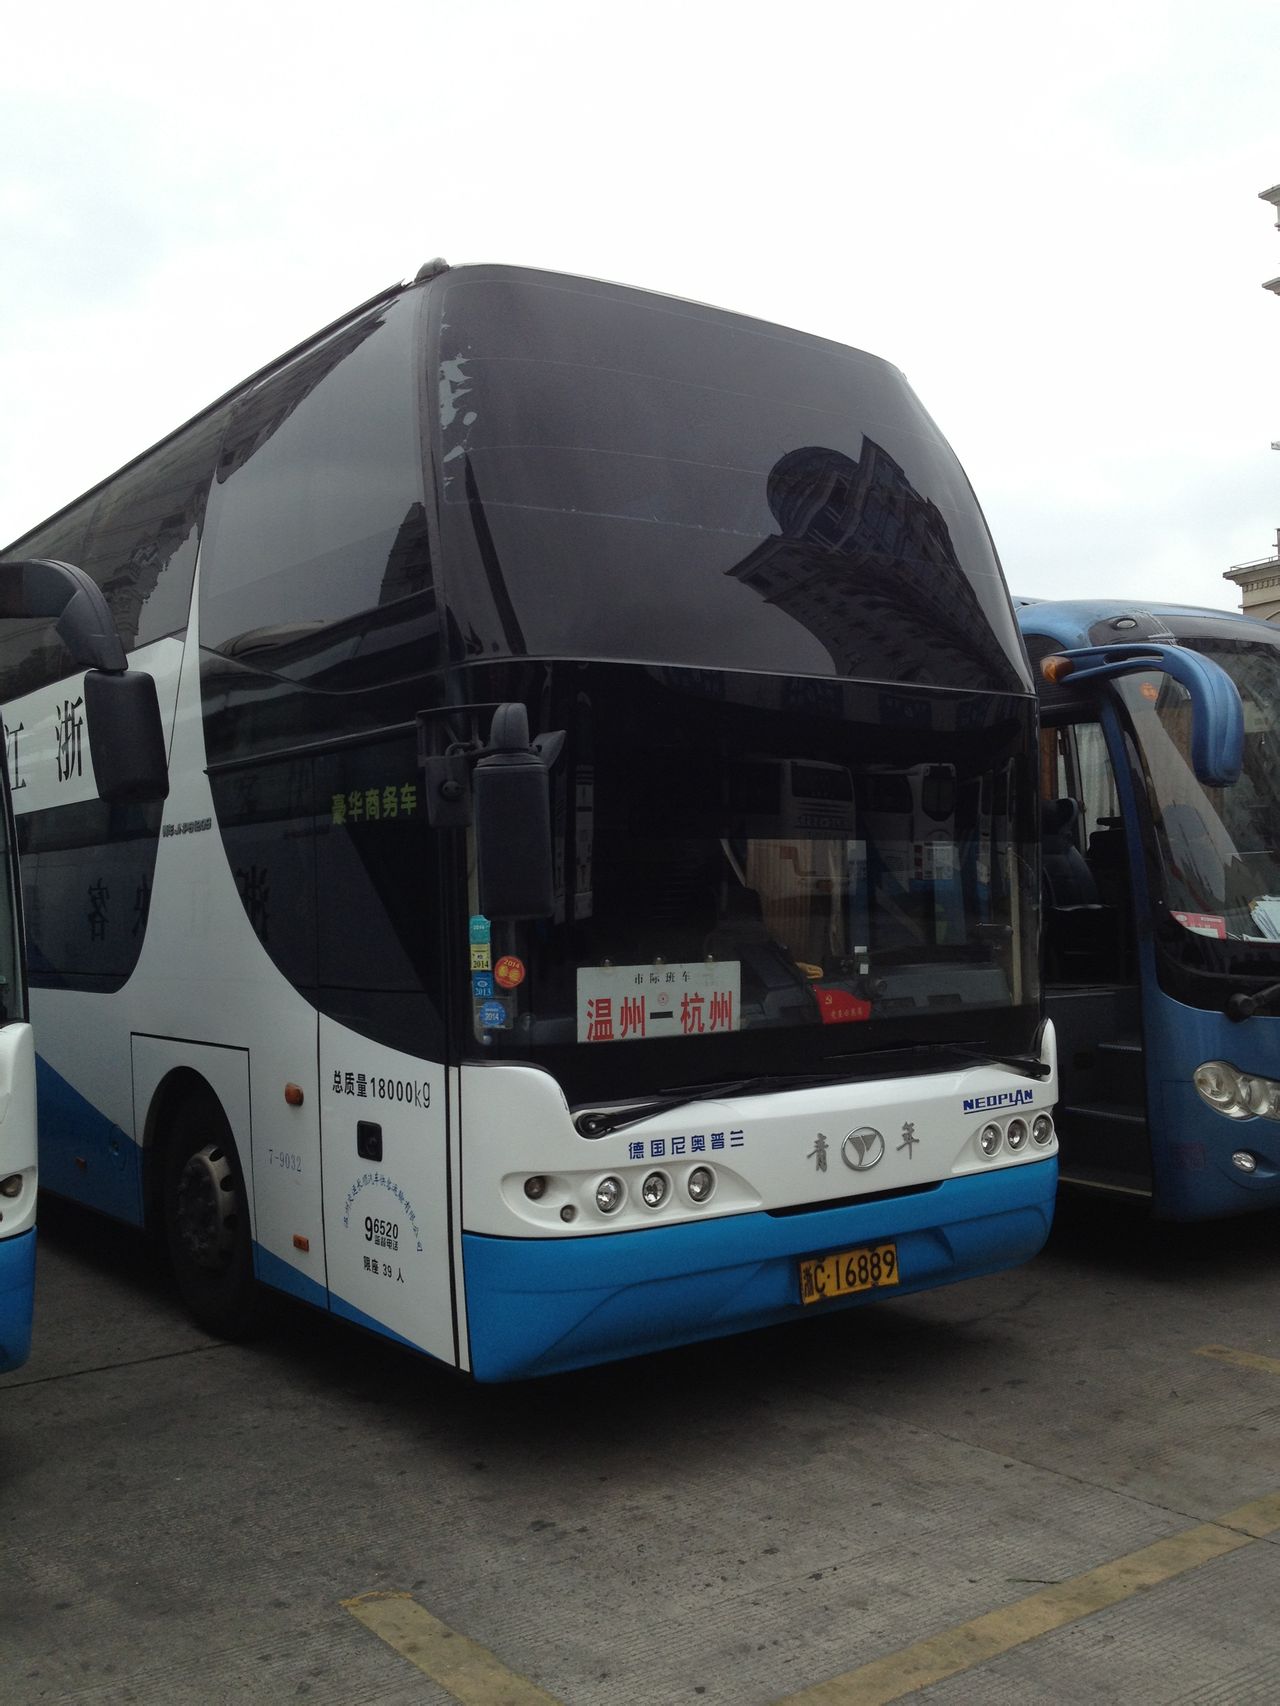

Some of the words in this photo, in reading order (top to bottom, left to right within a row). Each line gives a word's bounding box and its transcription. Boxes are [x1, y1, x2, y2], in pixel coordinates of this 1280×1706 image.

[55, 696, 83, 783] 浙
[472, 960, 489, 969] 2014
[503, 959, 521, 969] 2014
[475, 987, 492, 996] 2013
[484, 1012, 499, 1021] 2014
[963, 1089, 1034, 1113] NEOPLAN
[628, 1129, 745, 1160] 德国尼奥普兰
[364, 1216, 399, 1242] 96520
